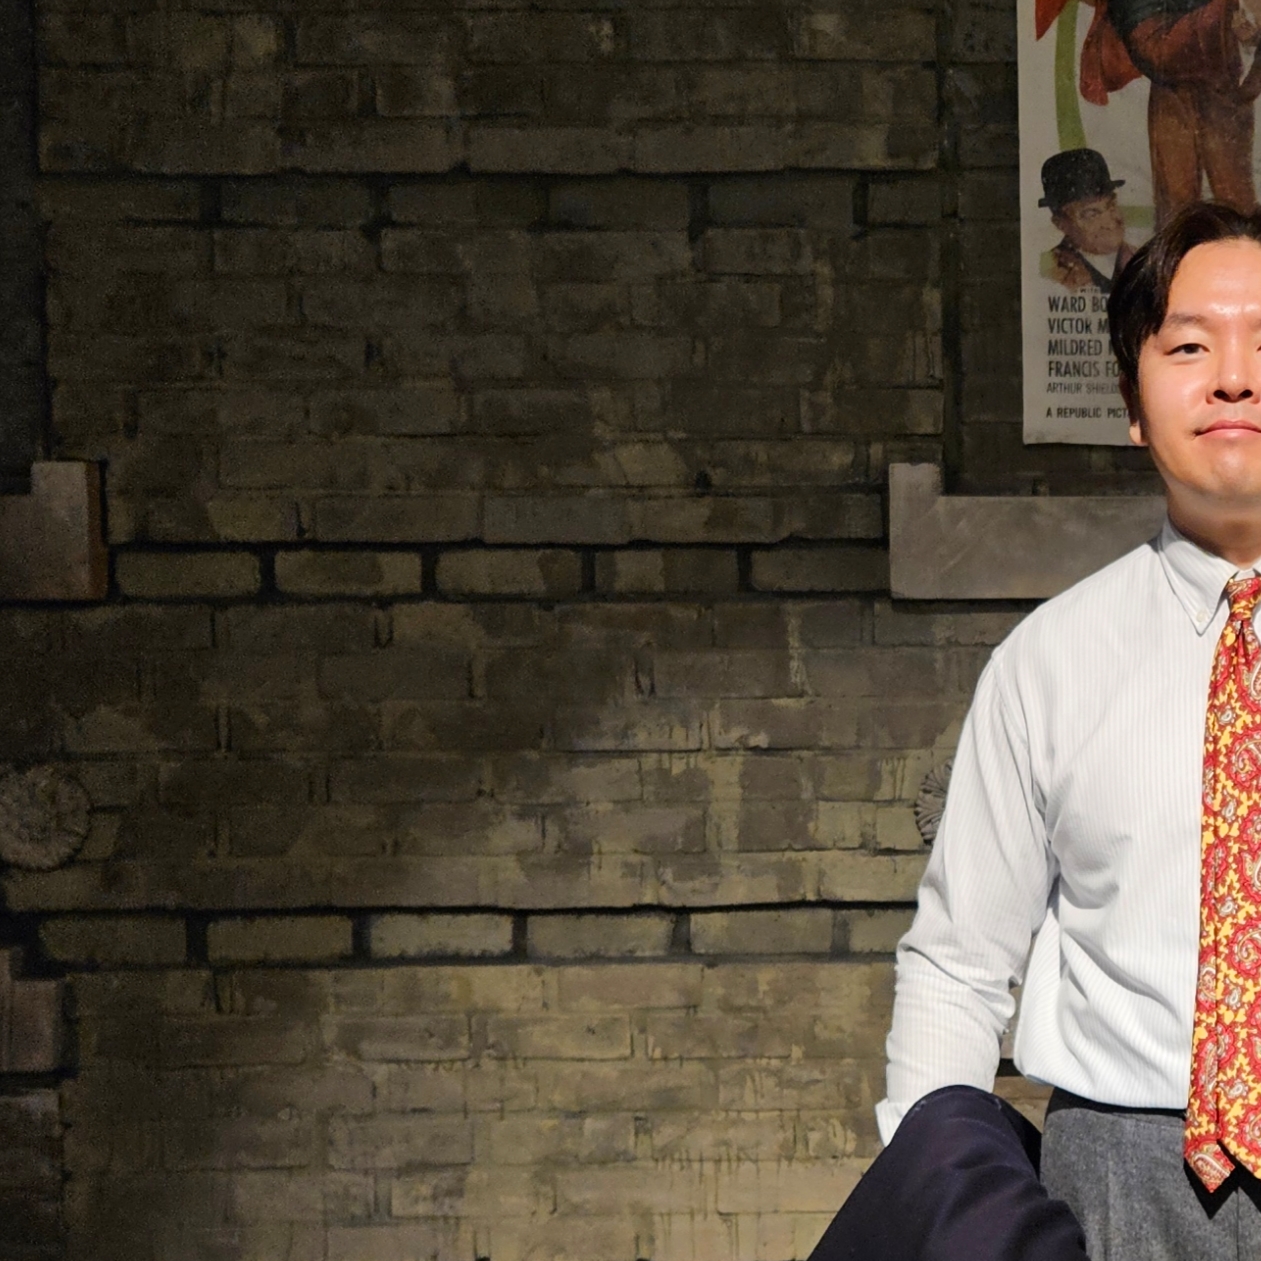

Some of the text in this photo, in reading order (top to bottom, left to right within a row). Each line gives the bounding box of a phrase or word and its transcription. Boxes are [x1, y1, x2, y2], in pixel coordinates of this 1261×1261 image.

[1048, 296, 1110, 313] WARD BO
[1047, 339, 1103, 356] MILDRED
[1048, 361, 1100, 377] FRANCIS
[1046, 382, 1120, 395] ARTHUR SHIELD
[1046, 407, 1129, 418] A REPUBLIC PICT
